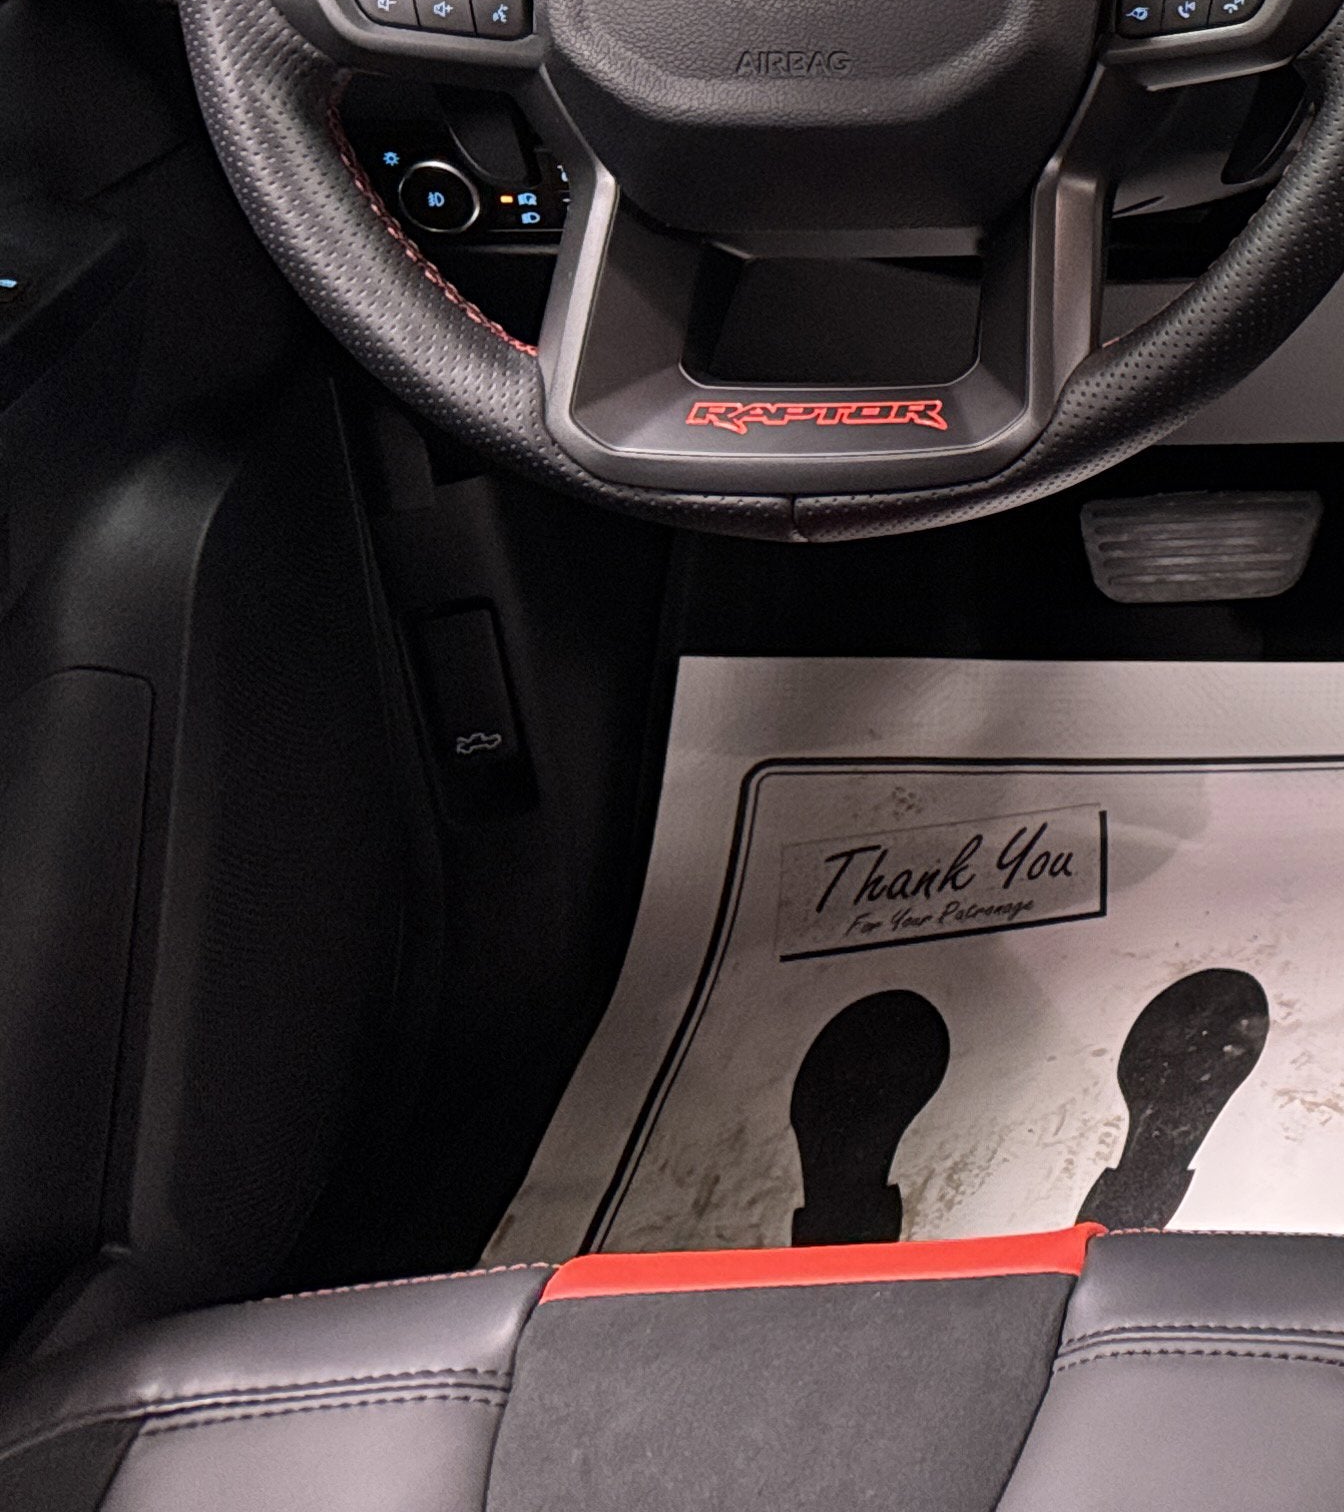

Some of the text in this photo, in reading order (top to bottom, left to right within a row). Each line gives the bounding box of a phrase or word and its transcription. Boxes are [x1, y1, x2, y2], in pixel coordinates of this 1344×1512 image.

[735, 50, 854, 76] AIRBAG
[685, 399, 948, 435] RAPTOR
[815, 822, 1074, 914] Thank You
[845, 898, 1035, 937] For Your Patronage
